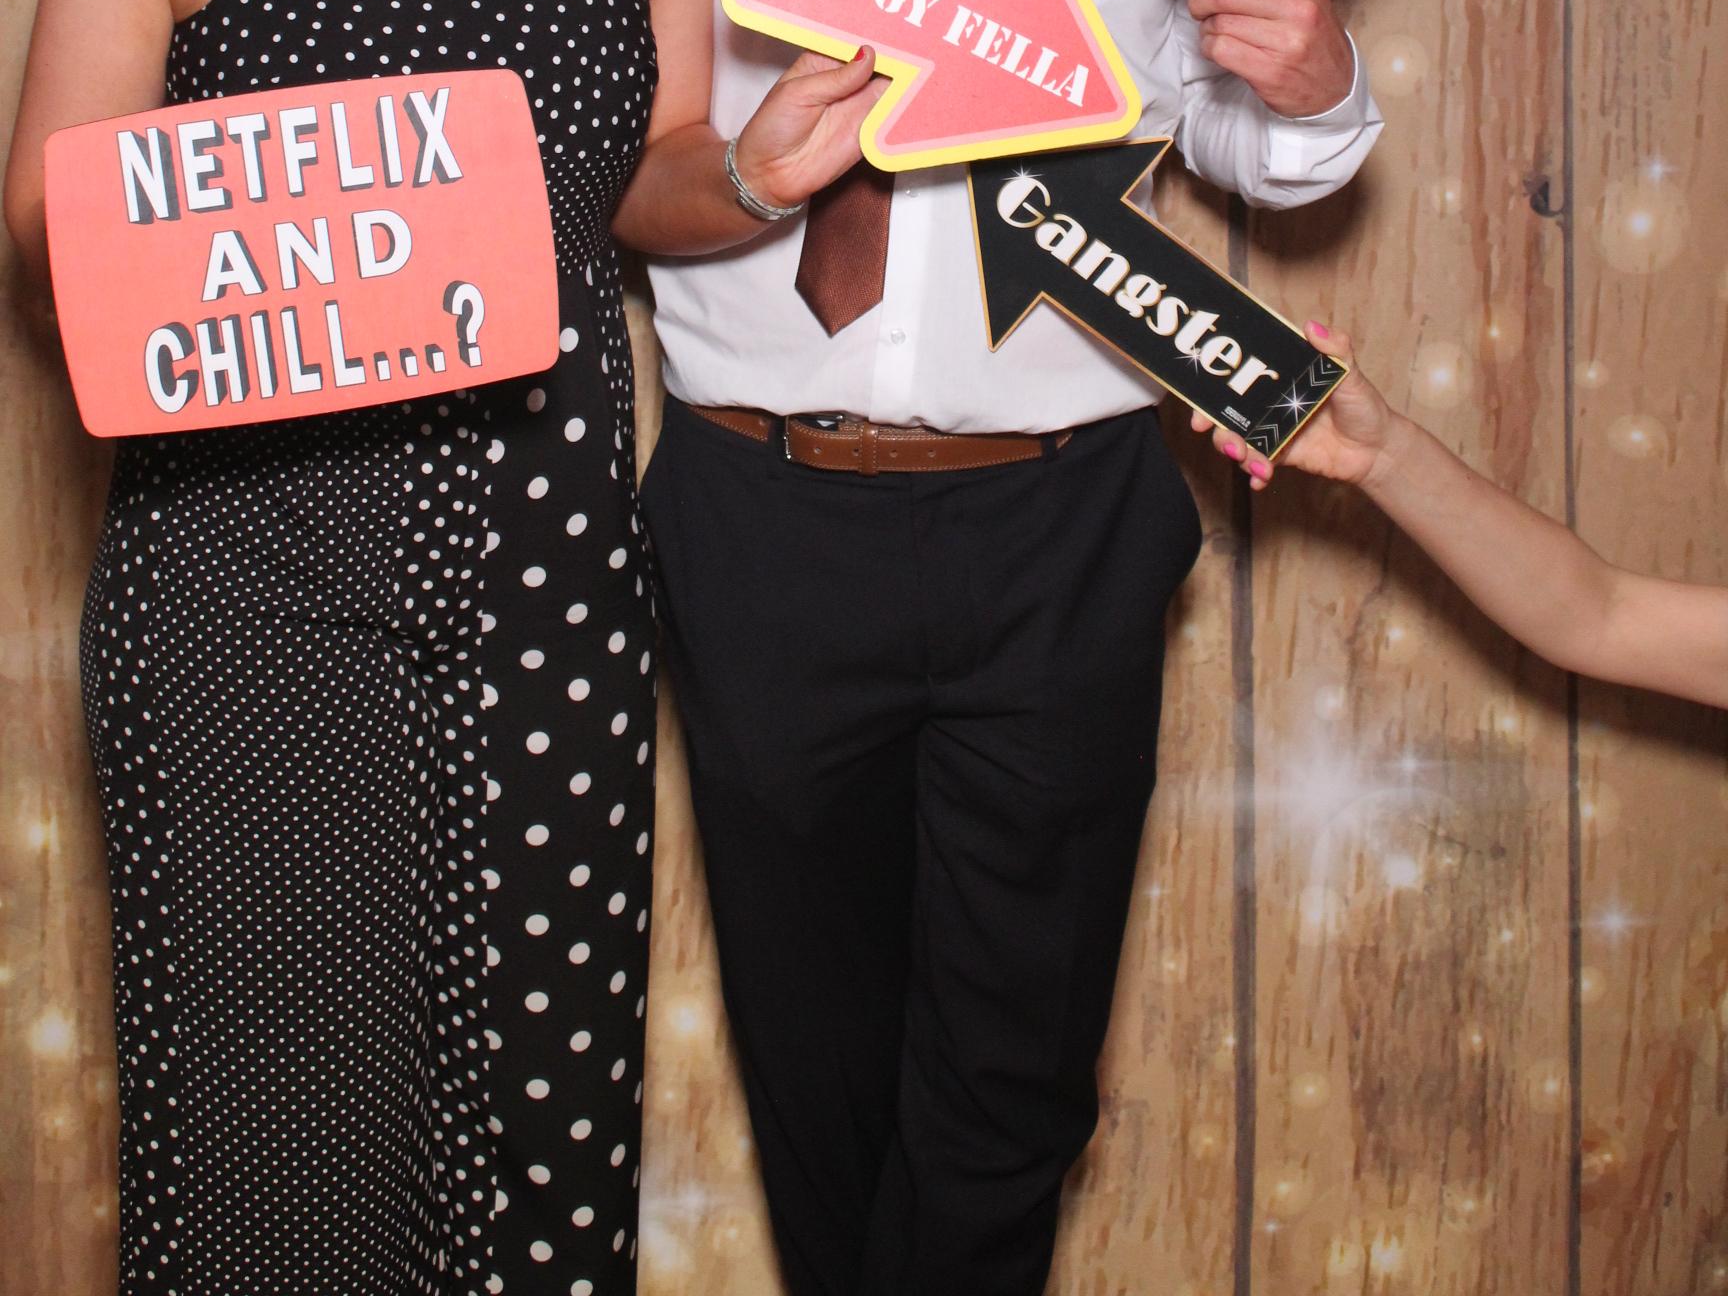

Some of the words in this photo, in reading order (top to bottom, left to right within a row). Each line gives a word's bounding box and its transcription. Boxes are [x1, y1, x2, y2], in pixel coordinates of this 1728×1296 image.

[942, 4, 1090, 107] FELLA
[116, 87, 463, 225] NETFLIX
[201, 209, 412, 302] AND
[996, 176, 1280, 397] Gangster
[143, 280, 486, 414] CHILL...?
